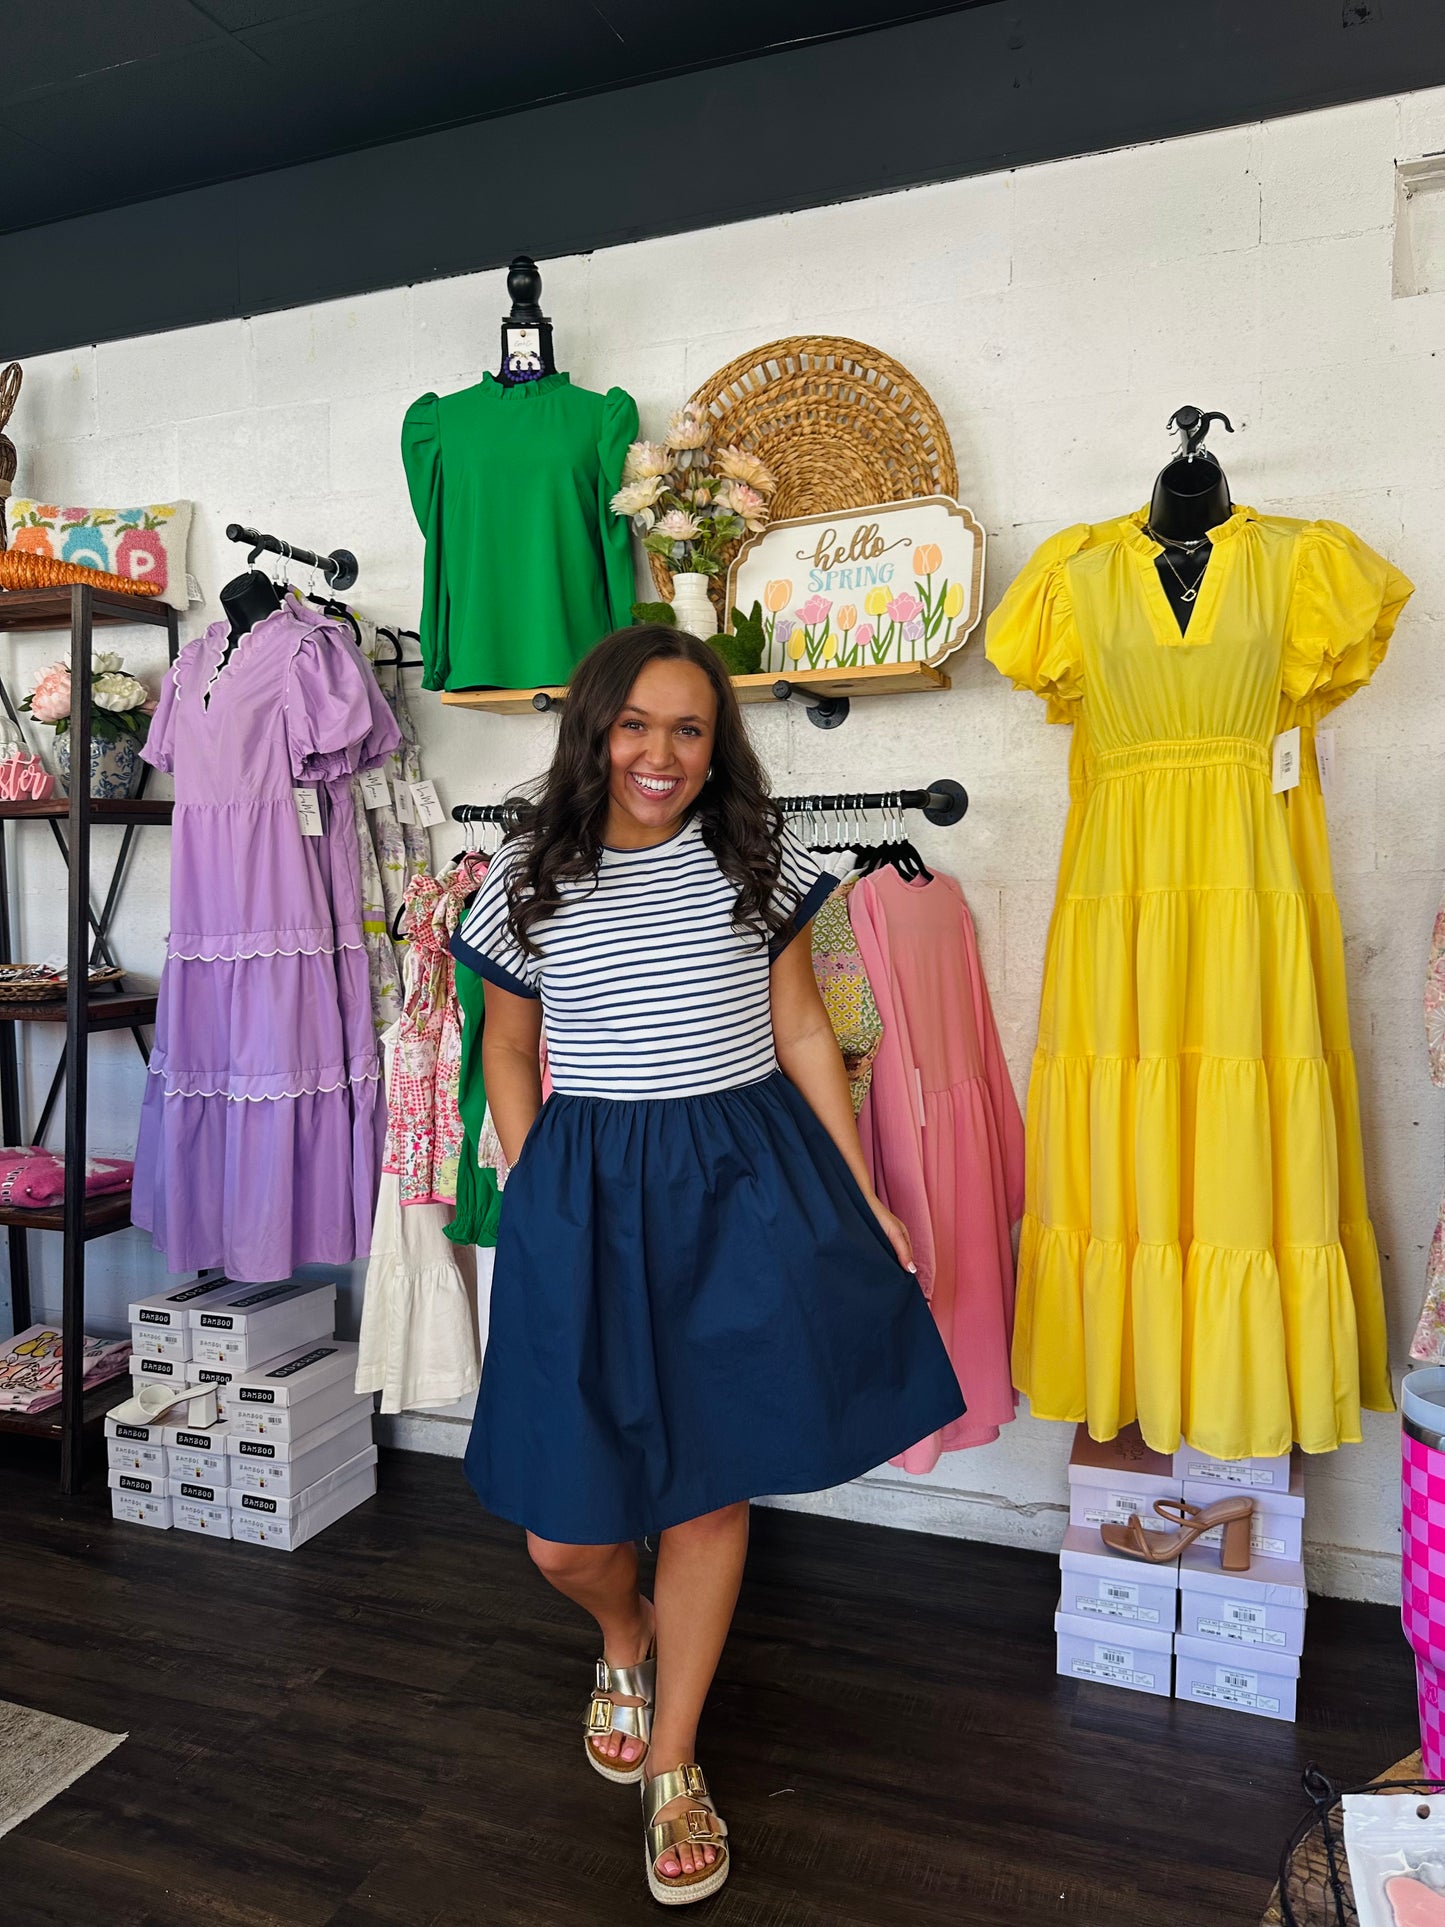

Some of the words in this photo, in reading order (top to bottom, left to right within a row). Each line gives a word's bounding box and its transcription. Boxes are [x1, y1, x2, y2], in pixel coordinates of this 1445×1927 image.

[796, 523, 912, 571] hello
[808, 562, 895, 592] SPRING
[141, 1311, 169, 1323] BAMBOO
[202, 1316, 231, 1327] BAMBOO
[142, 1362, 172, 1373] BAMBOO
[200, 1372, 231, 1383] BAMBOO
[241, 1390, 273, 1401] BAMBOO
[117, 1427, 147, 1439] BAMBOO
[178, 1435, 209, 1447] BAMBOO
[241, 1443, 273, 1455] BAMBOO
[121, 1478, 150, 1490] BAMBOO
[182, 1485, 212, 1498] BAMBOO
[243, 1497, 275, 1510] BAMBOO
